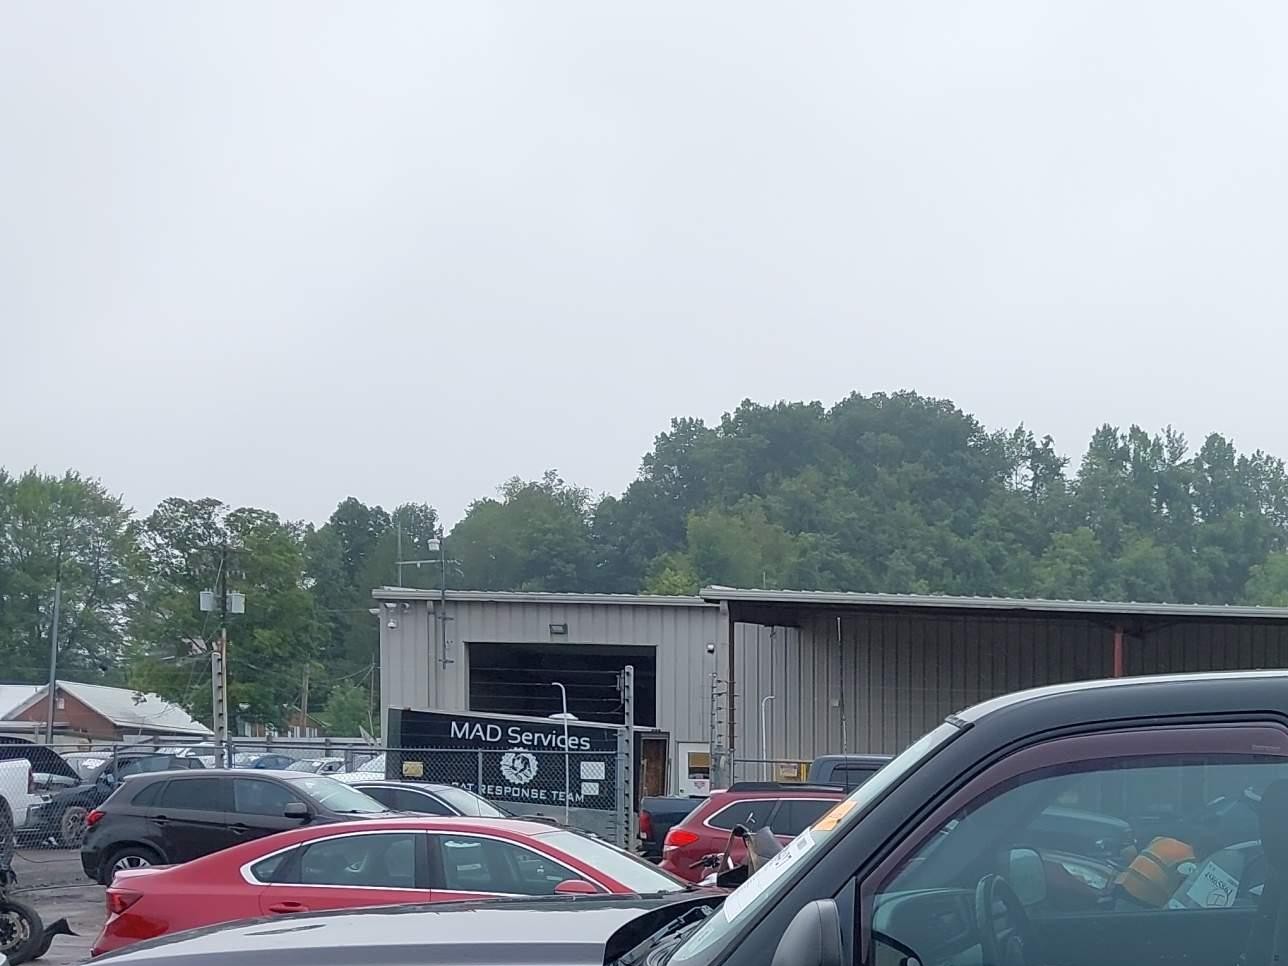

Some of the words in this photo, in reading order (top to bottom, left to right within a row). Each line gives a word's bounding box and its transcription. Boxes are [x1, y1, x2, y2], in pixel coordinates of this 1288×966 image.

[450, 721, 502, 743] MAD
[507, 727, 591, 750] Services
[480, 785, 548, 800] RESPONSE
[551, 790, 585, 803] TEAM
